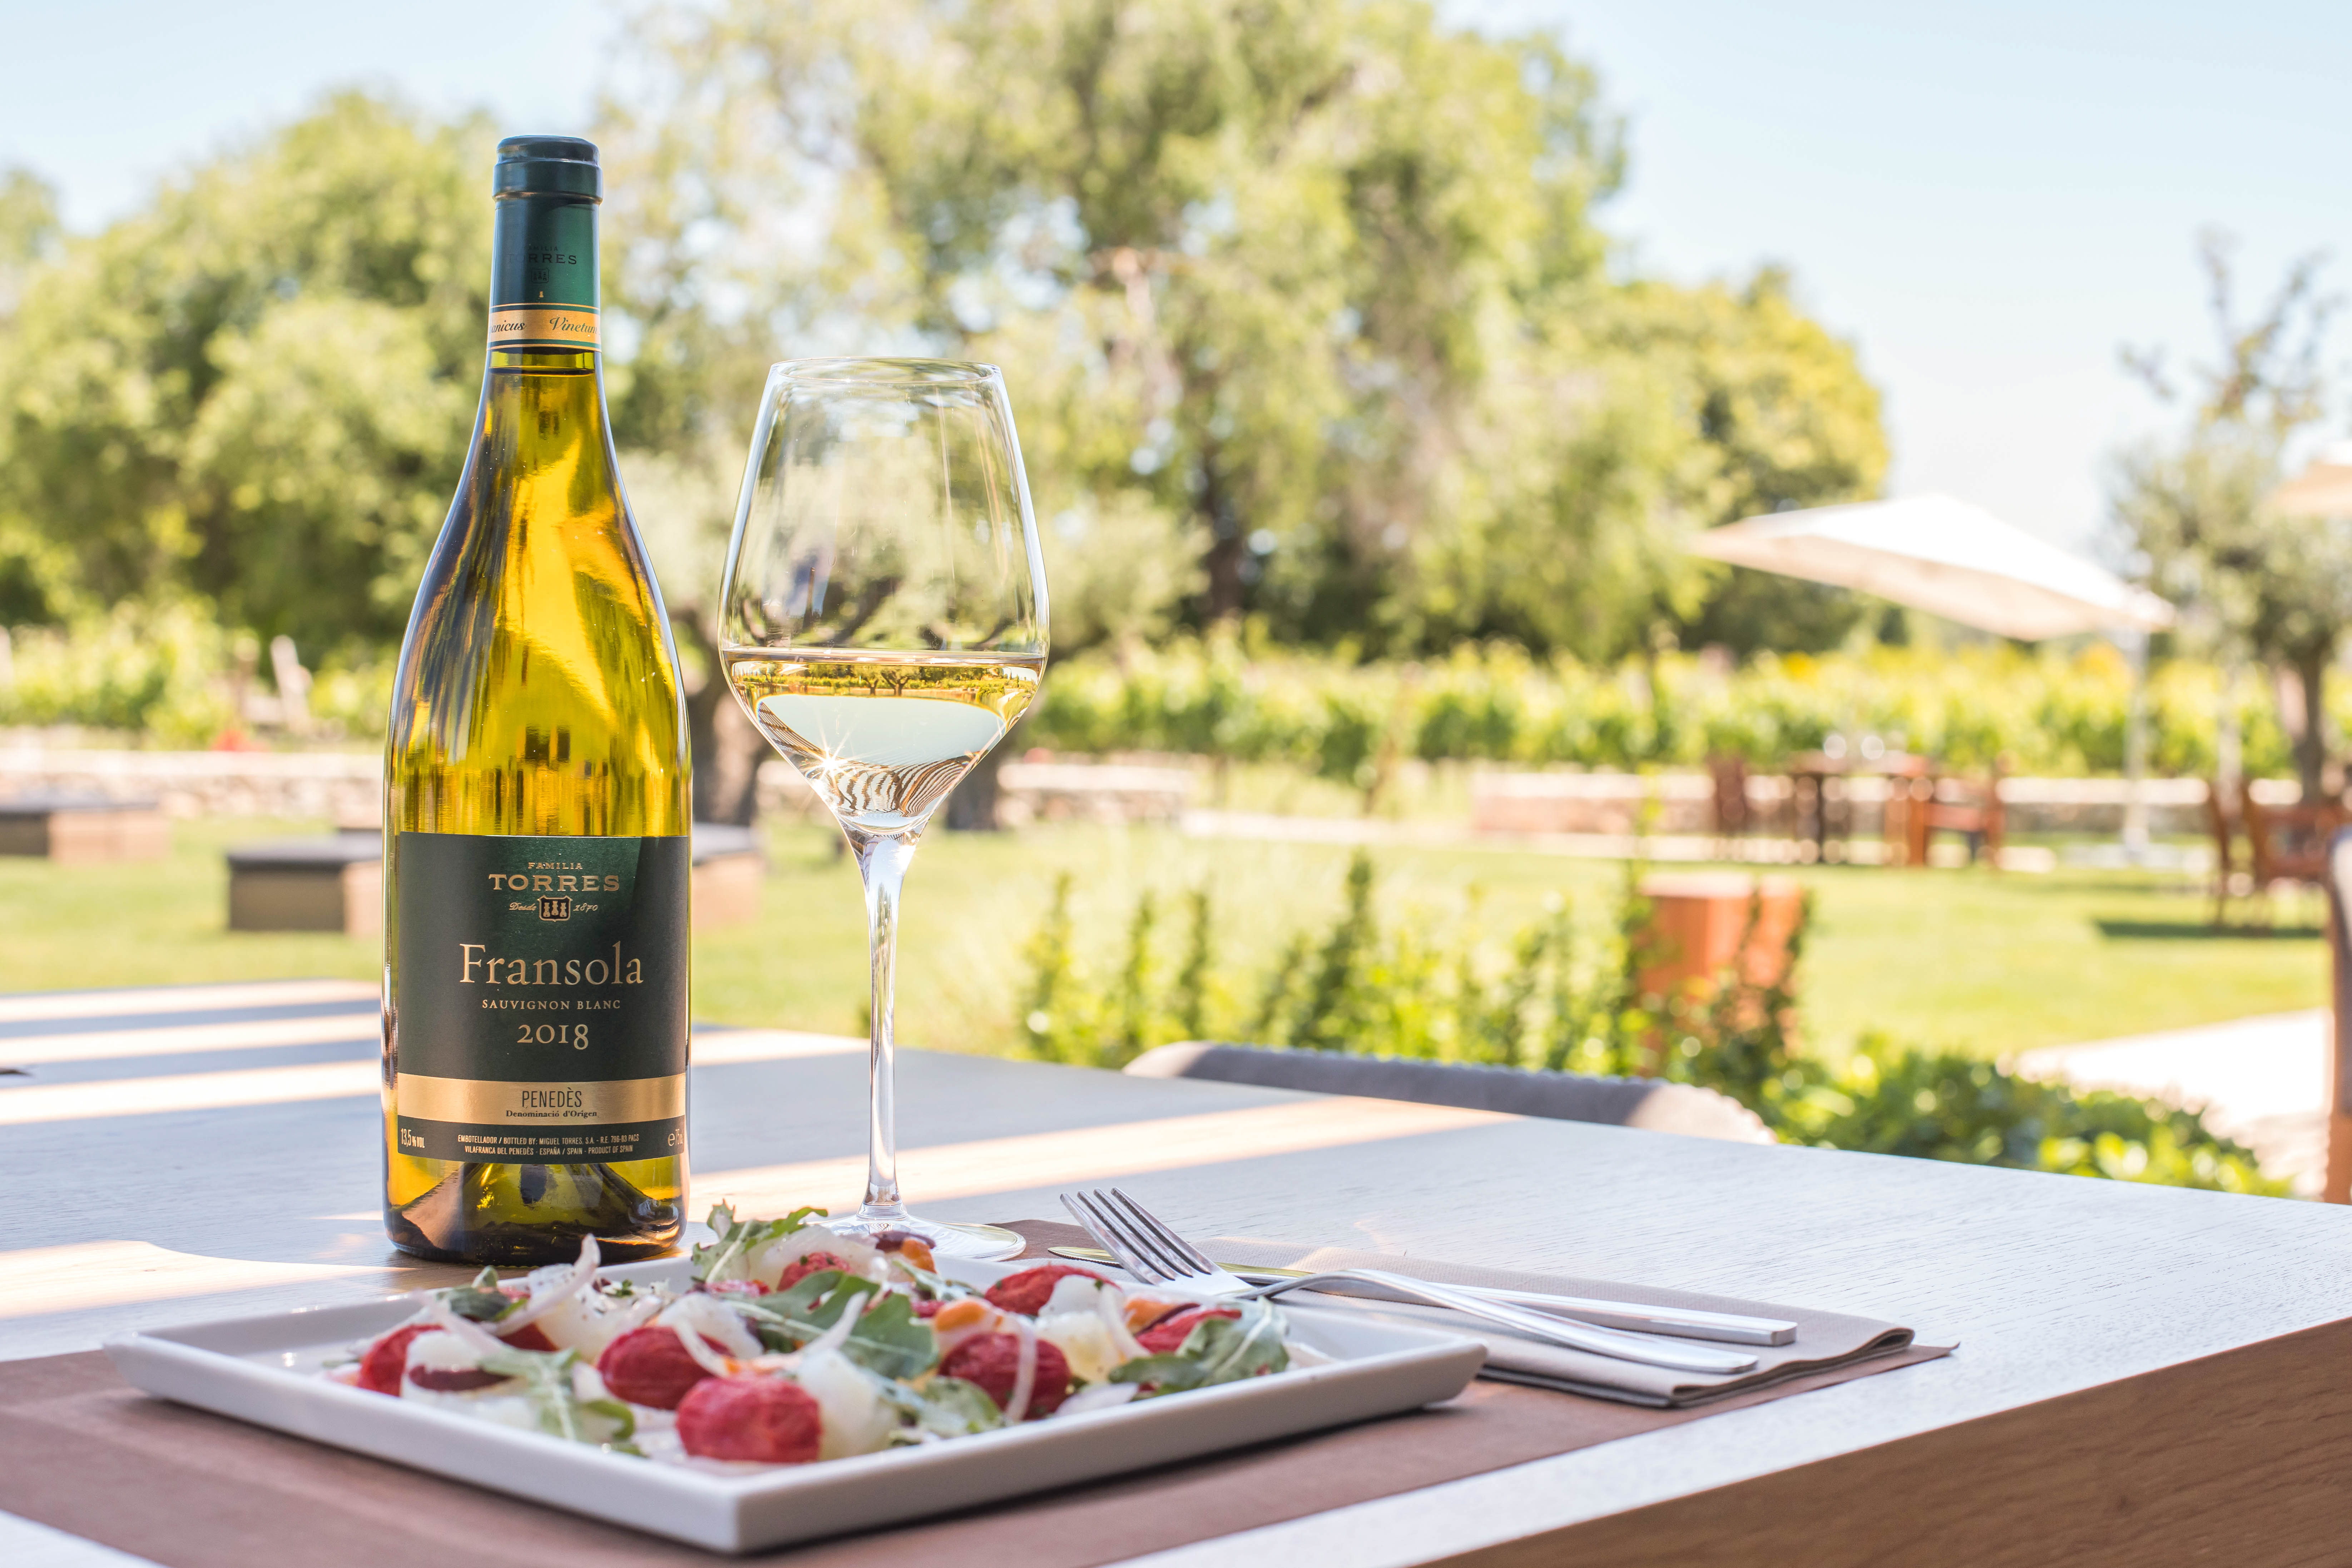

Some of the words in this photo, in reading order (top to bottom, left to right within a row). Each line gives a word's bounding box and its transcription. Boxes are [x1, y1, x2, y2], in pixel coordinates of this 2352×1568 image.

[549, 317, 597, 334] Vinetum
[489, 874, 620, 891] TORRES
[509, 902, 537, 911] Desde
[573, 903, 599, 913] 1870
[459, 941, 644, 985] Fransola
[482, 999, 570, 1010] SAUVIGNON
[577, 1000, 621, 1009] BLANC
[517, 1024, 589, 1050] 2018
[522, 1087, 582, 1108] PENEDÈS
[563, 1110, 597, 1119] d'Origen
[400, 1128, 412, 1147] 13,5
[458, 1134, 497, 1144] EMBOTELLADOR
[465, 1145, 496, 1154] VILAFRANCA
[509, 1147, 534, 1155] PENEDÈS
[540, 1147, 560, 1155] ESPAÑA
